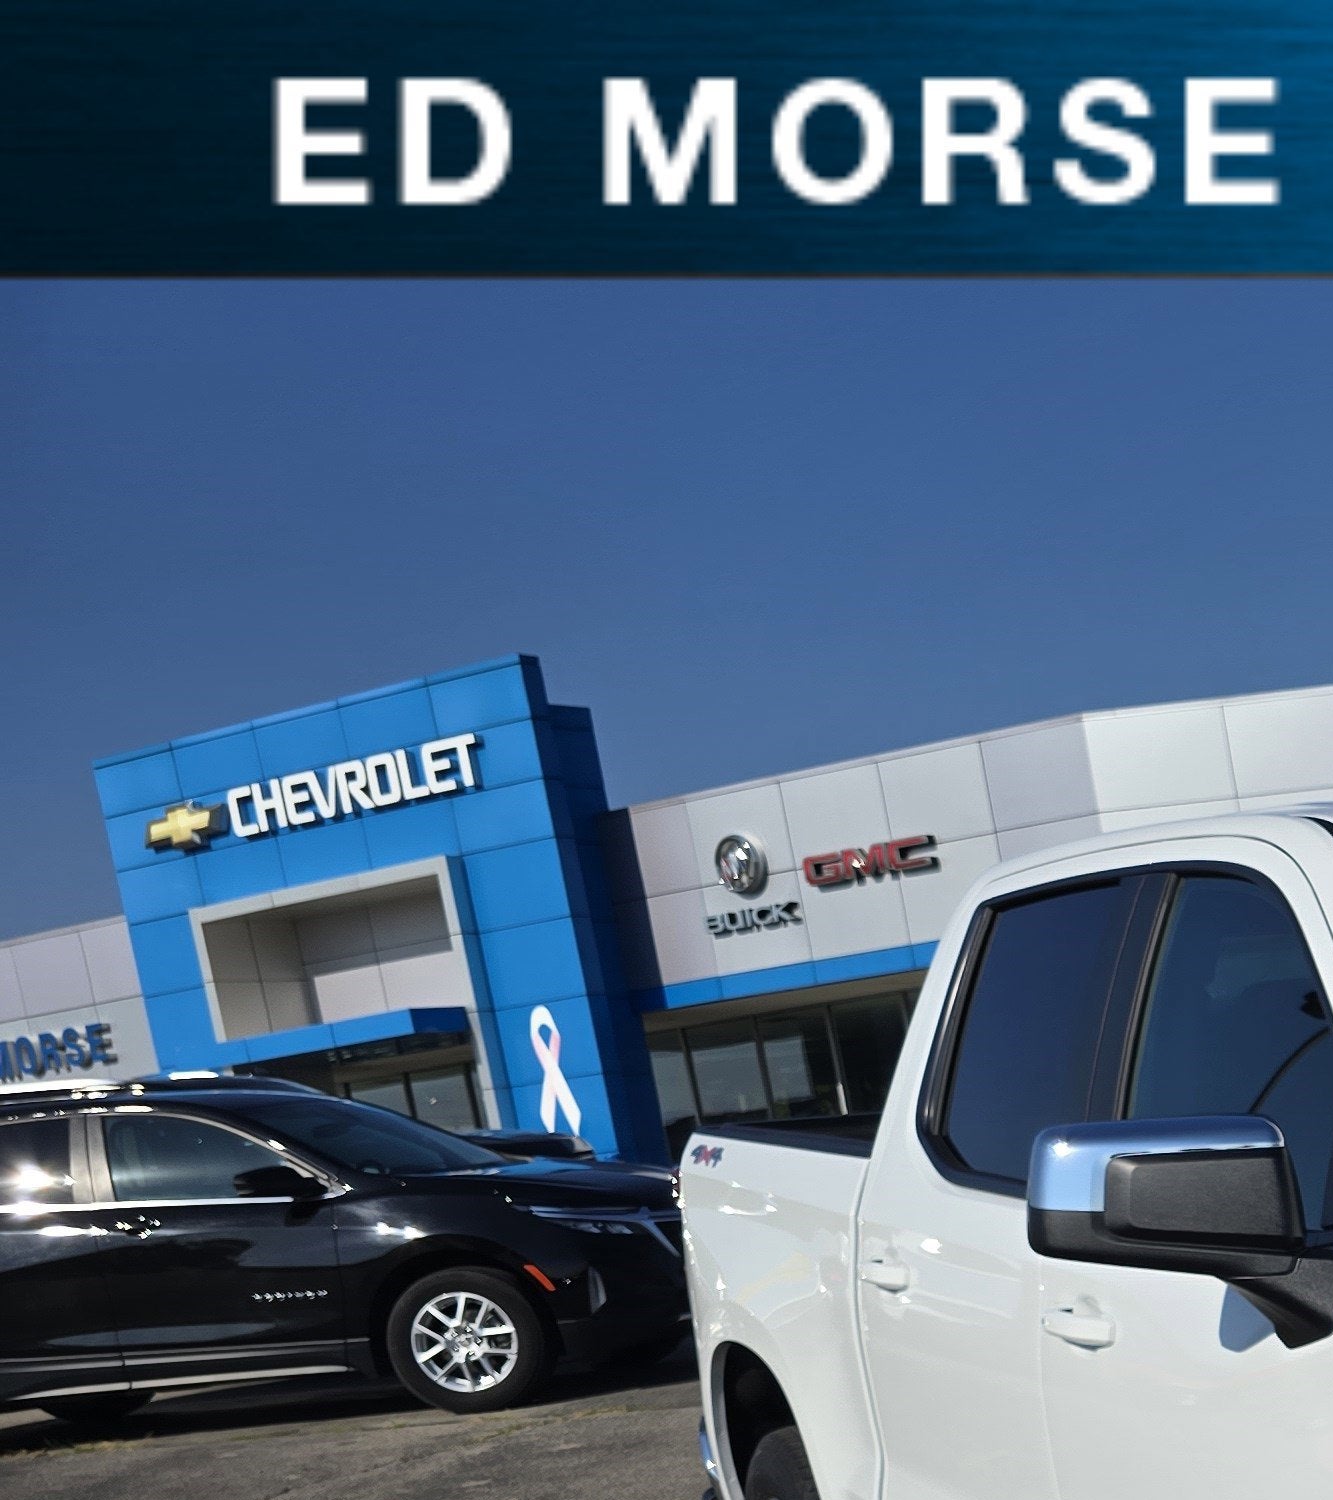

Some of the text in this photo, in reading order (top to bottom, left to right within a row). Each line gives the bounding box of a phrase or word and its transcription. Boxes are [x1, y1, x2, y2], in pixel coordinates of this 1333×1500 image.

[226, 732, 477, 838] CHEVROLET
[803, 835, 939, 889] GMC
[706, 901, 801, 938] BUICK
